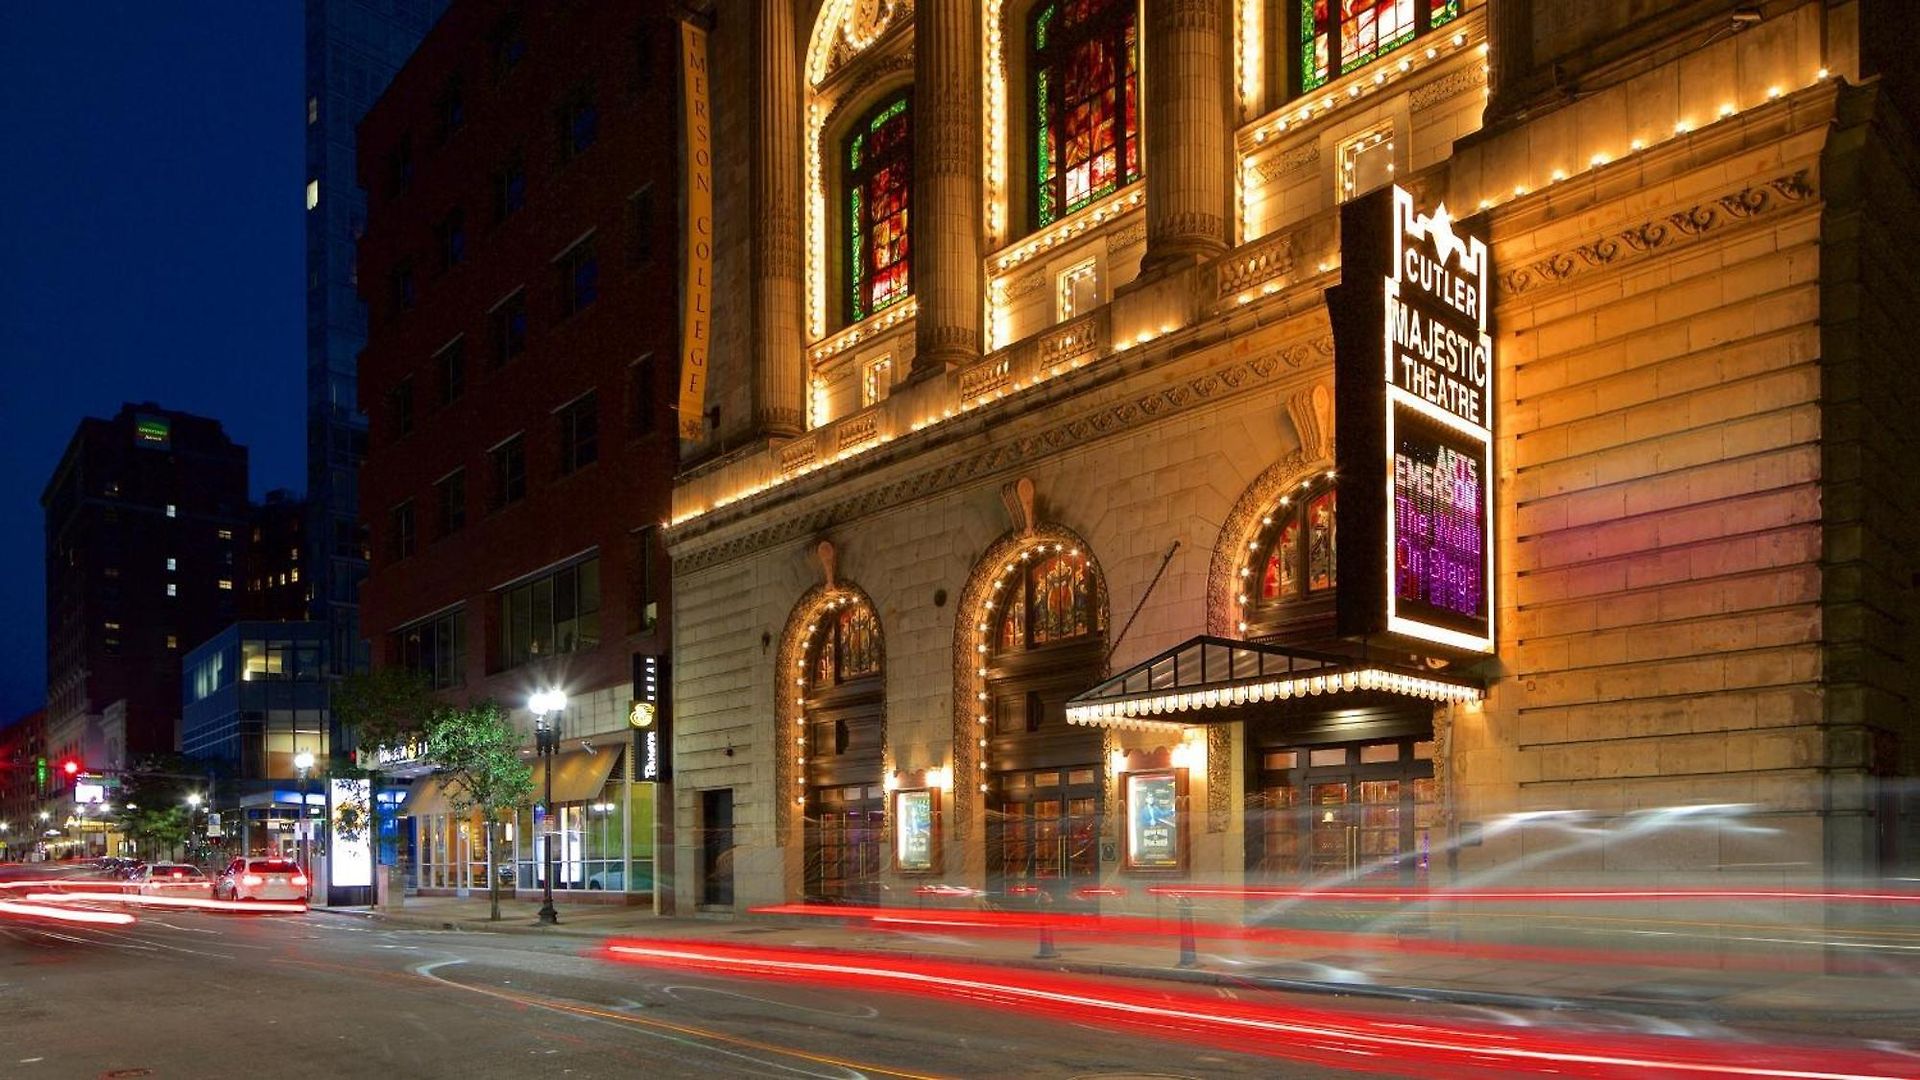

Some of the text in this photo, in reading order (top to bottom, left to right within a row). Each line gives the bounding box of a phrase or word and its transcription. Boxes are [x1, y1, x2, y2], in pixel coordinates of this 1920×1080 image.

[690, 31, 710, 394] EMERSON COLLEGE
[1405, 248, 1477, 319] CUTLER
[1392, 300, 1486, 387] MAJESTIC
[1401, 354, 1479, 423] THEATRE
[1395, 453, 1477, 513] EMERSON
[1435, 445, 1477, 485] ARTS
